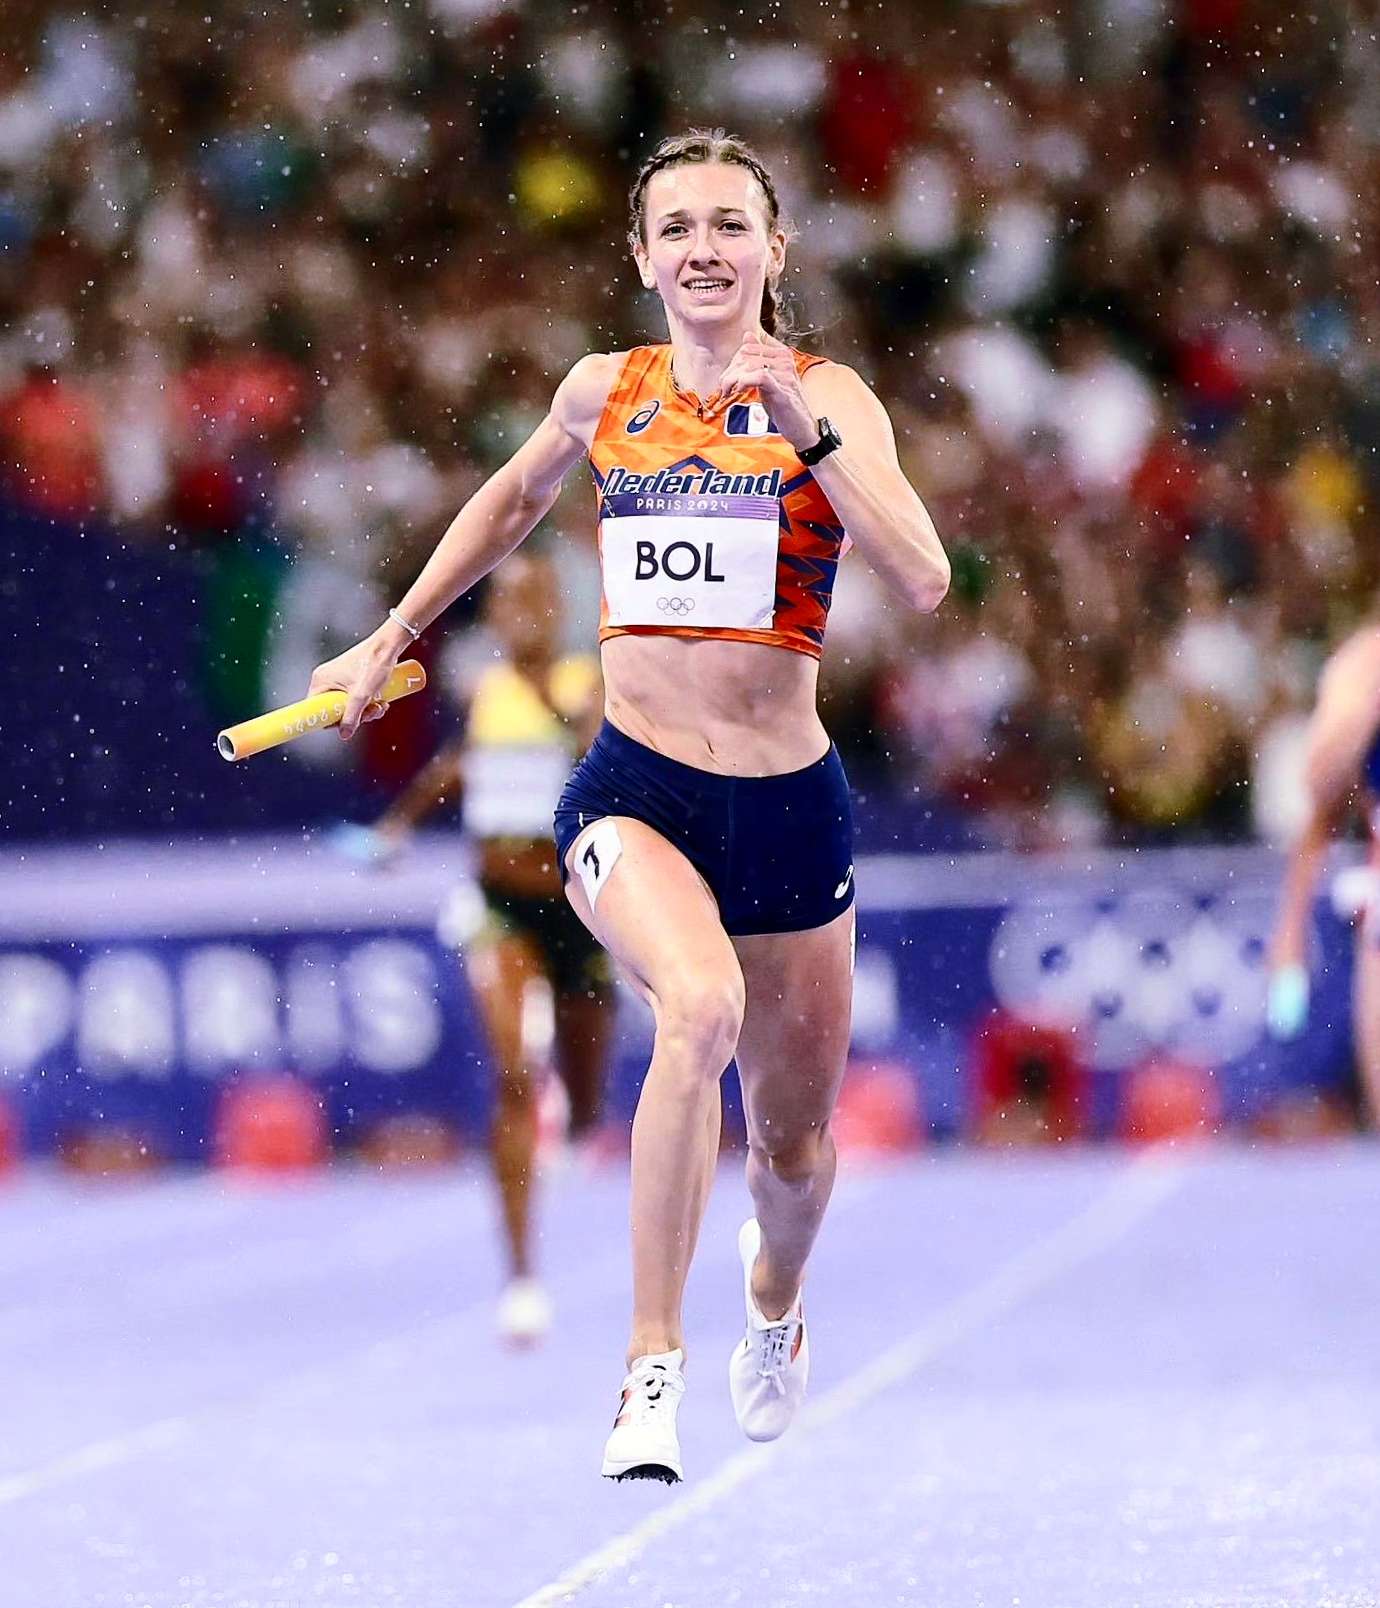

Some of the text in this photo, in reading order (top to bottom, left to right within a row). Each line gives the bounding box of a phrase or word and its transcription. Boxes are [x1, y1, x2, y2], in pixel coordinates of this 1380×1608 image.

[637, 498, 728, 512] PARIS 2024
[635, 540, 725, 582] BOL
